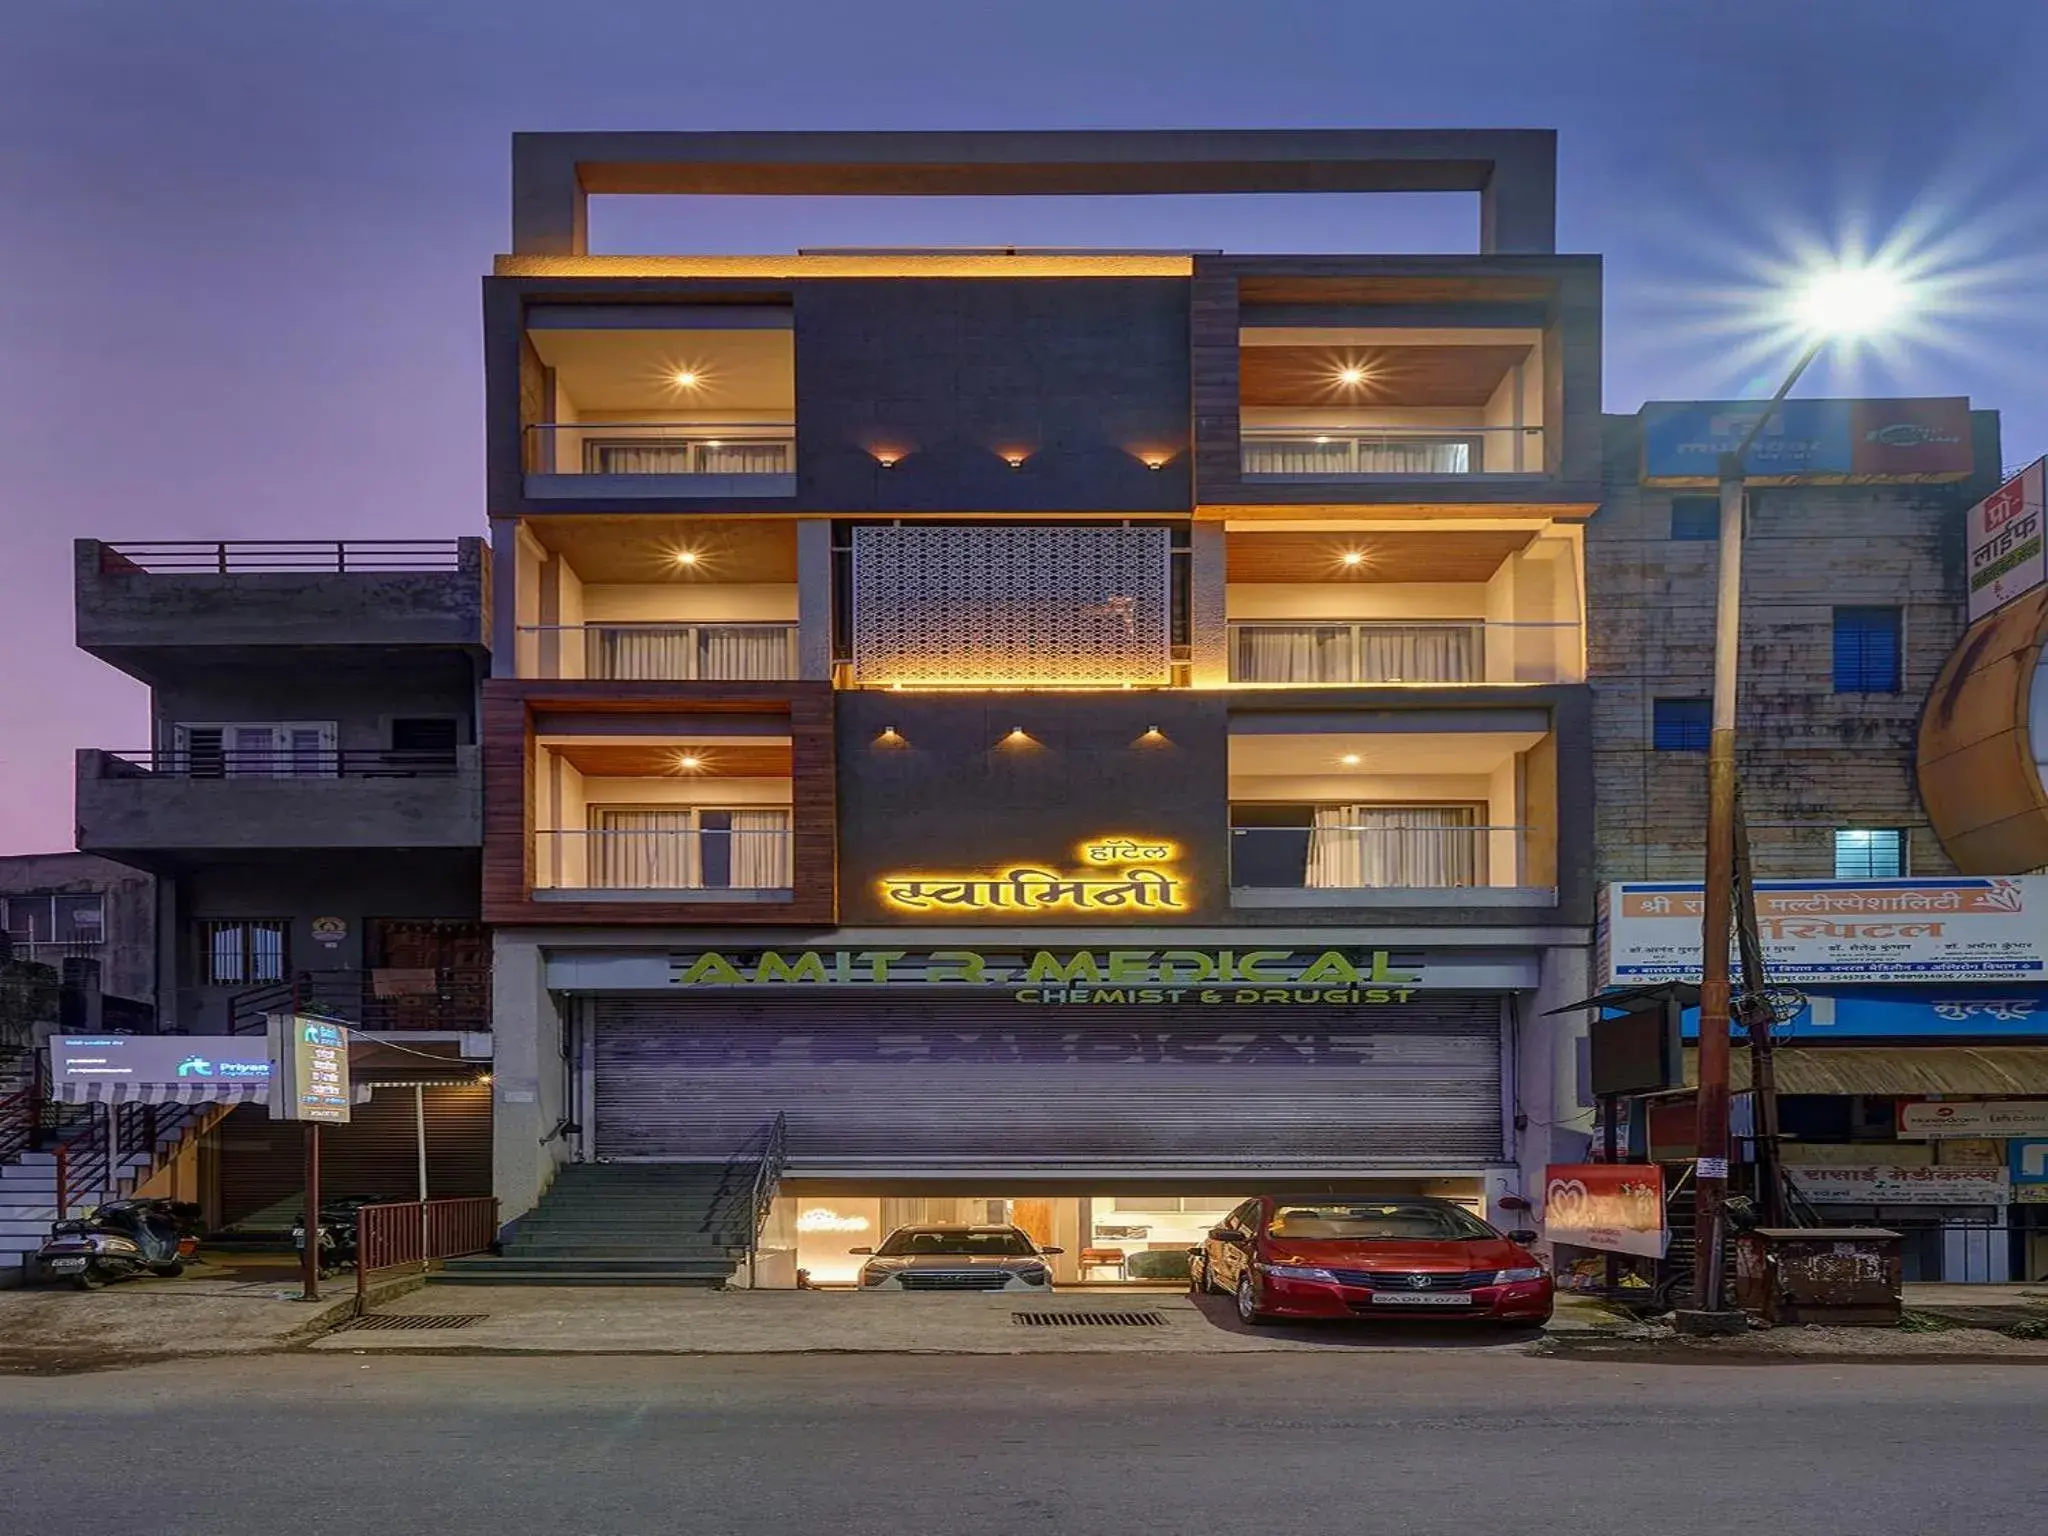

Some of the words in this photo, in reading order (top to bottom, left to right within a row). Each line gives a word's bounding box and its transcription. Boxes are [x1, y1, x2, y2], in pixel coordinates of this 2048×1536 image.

[1972, 511, 2039, 568] लाईफ
[1087, 840, 1169, 860] हॉटेल
[885, 869, 1182, 907] स्वामिनी
[1640, 895, 1672, 914] श्री
[1768, 892, 1963, 913] मल्टीस्पेशालिटी
[679, 950, 906, 984] AMIT
[1024, 950, 1421, 984] MEDICAL
[1015, 988, 1187, 1005] CHEMIST
[1199, 988, 1222, 1004] &
[1235, 988, 1417, 1005] DRUGIST
